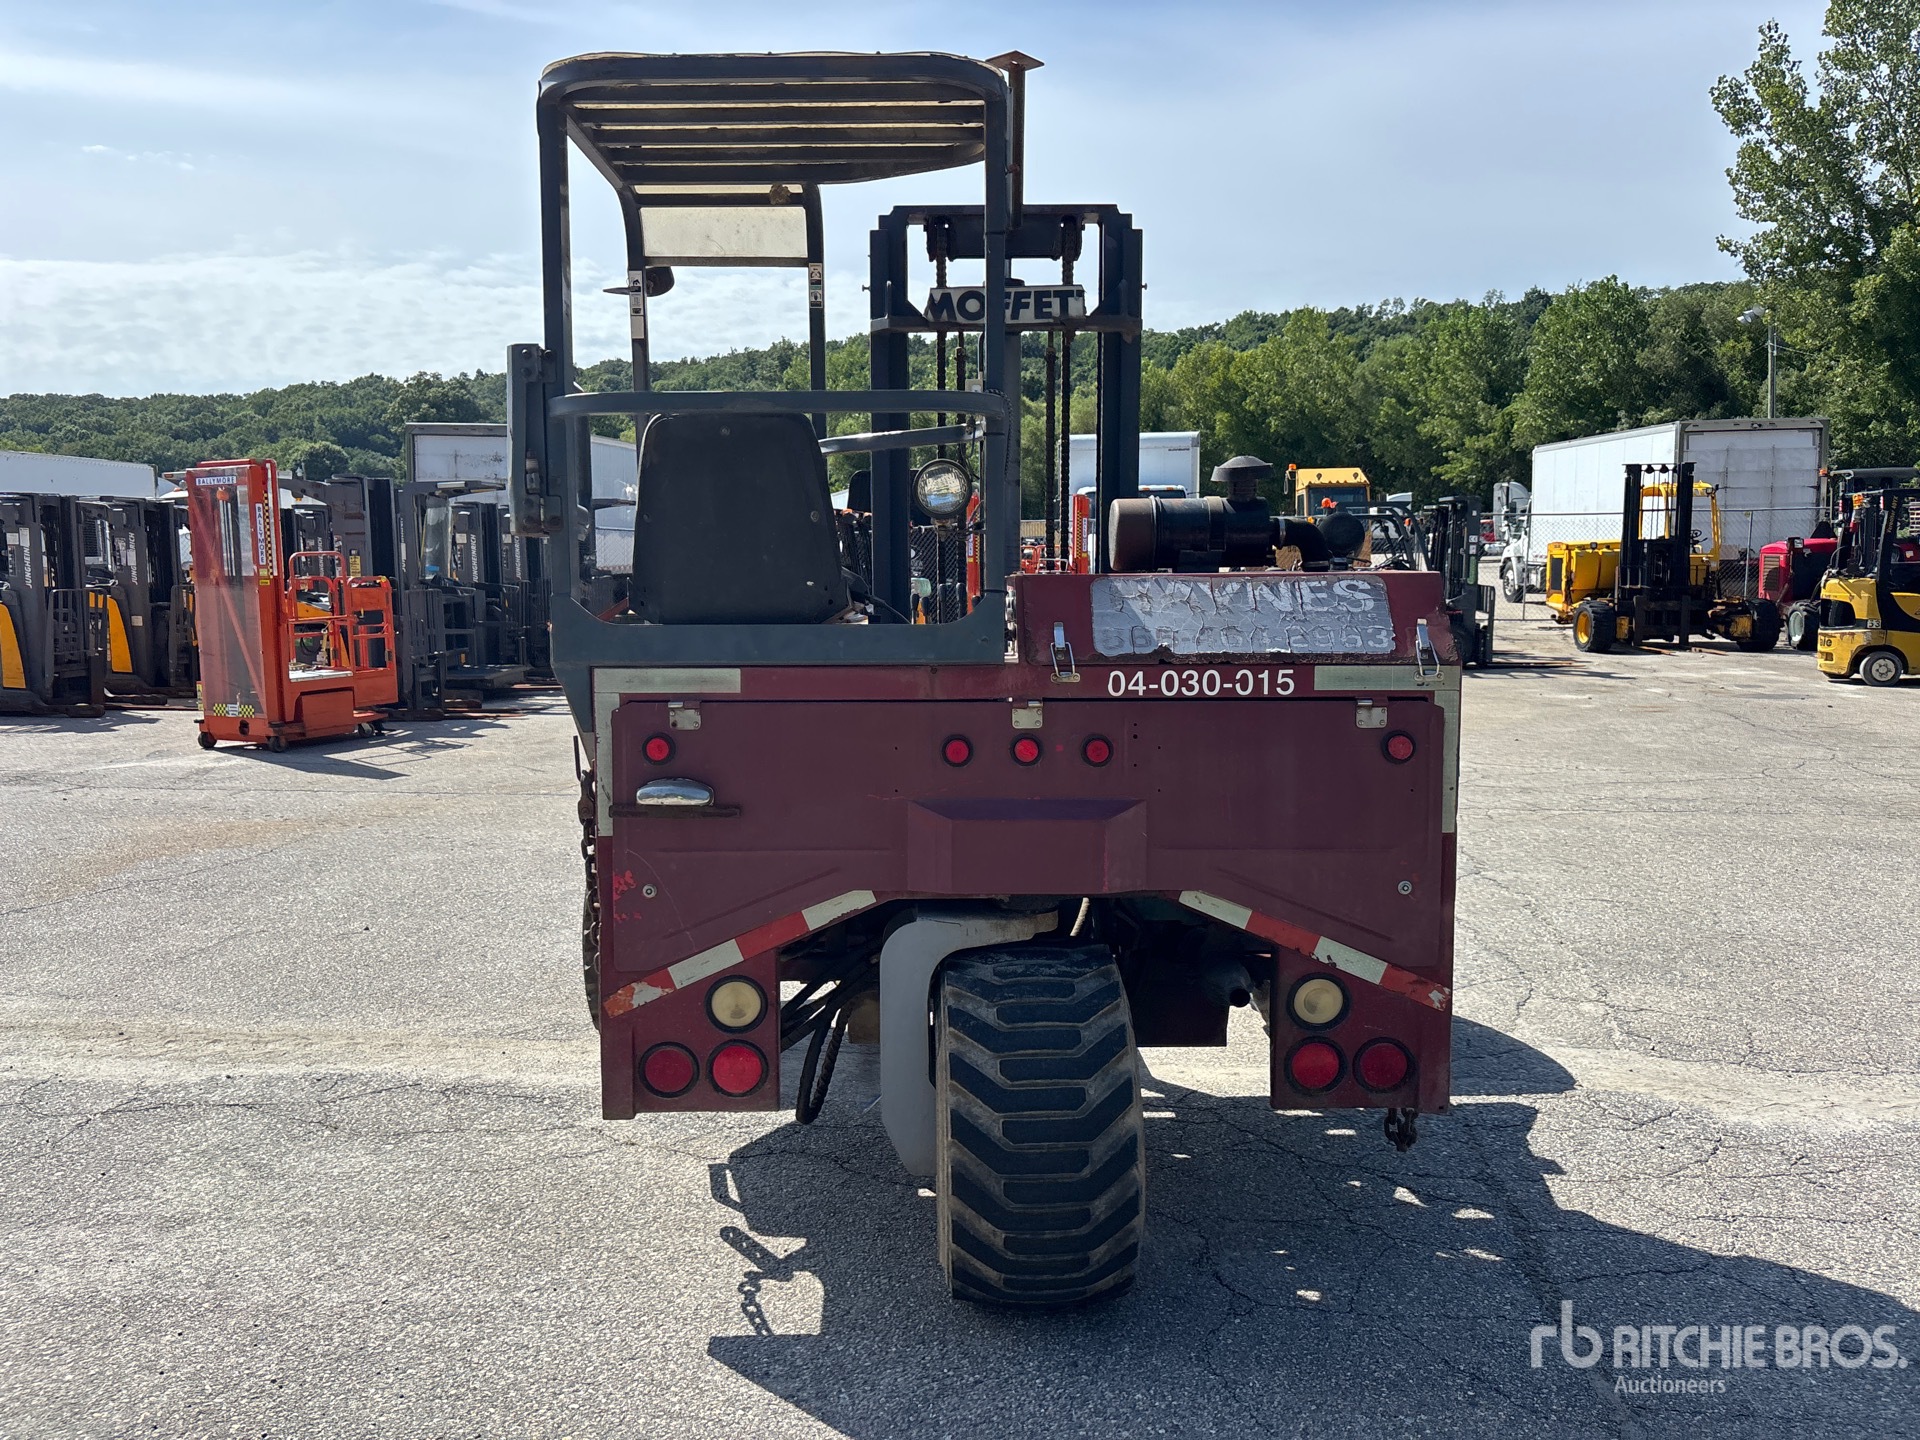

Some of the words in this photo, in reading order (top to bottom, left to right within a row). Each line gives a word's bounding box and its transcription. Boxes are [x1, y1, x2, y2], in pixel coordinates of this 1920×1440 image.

[925, 290, 1084, 321] MOFET
[197, 476, 235, 485] BALLYMORE
[256, 506, 265, 563] BALLYMORE
[1108, 669, 1295, 696] 04-030-015
